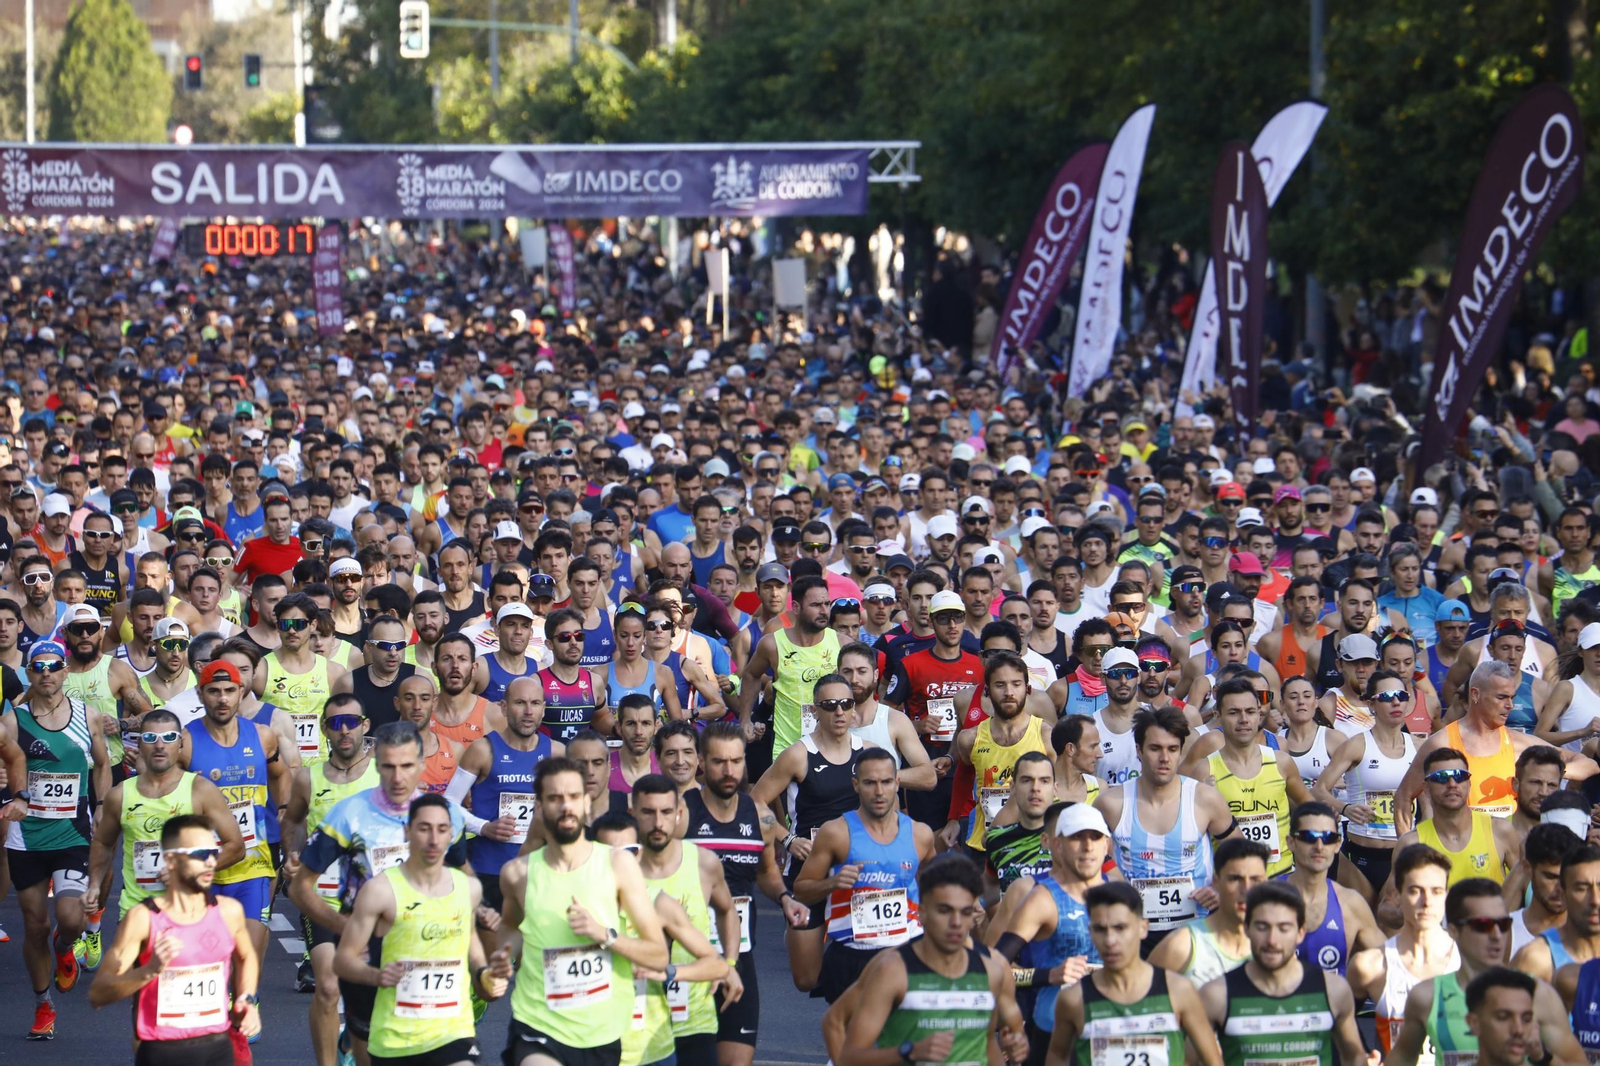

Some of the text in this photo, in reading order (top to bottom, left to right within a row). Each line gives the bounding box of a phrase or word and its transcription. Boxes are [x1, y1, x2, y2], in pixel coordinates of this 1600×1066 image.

[31, 160, 82, 176] MEDIA
[425, 164, 475, 180] MEDIA
[759, 162, 859, 181] AYUNTAMIENTO
[2, 172, 31, 193] 38
[31, 172, 115, 193] MARATÓN
[151, 161, 345, 205] SALIDA
[397, 176, 425, 197] 38
[425, 176, 506, 196] MARATÓN
[575, 169, 683, 193] IMDECO
[87, 194, 115, 207] 2024
[759, 182, 776, 200] DE
[1449, 113, 1573, 352] IMDECO
[1005, 182, 1081, 339] IMDECO
[314, 269, 339, 288] 1:30
[1483, 263, 1520, 320] Municipal
[318, 309, 342, 327] 1:30
[560, 709, 583, 722] LUCAS
[43, 783, 73, 797] 294
[1242, 825, 1271, 841] 399
[1159, 889, 1181, 906] 54
[872, 901, 902, 920] 162
[567, 956, 603, 977] 403
[183, 979, 216, 997] 410
[421, 973, 454, 990] 175
[1124, 1052, 1150, 1066] 23
